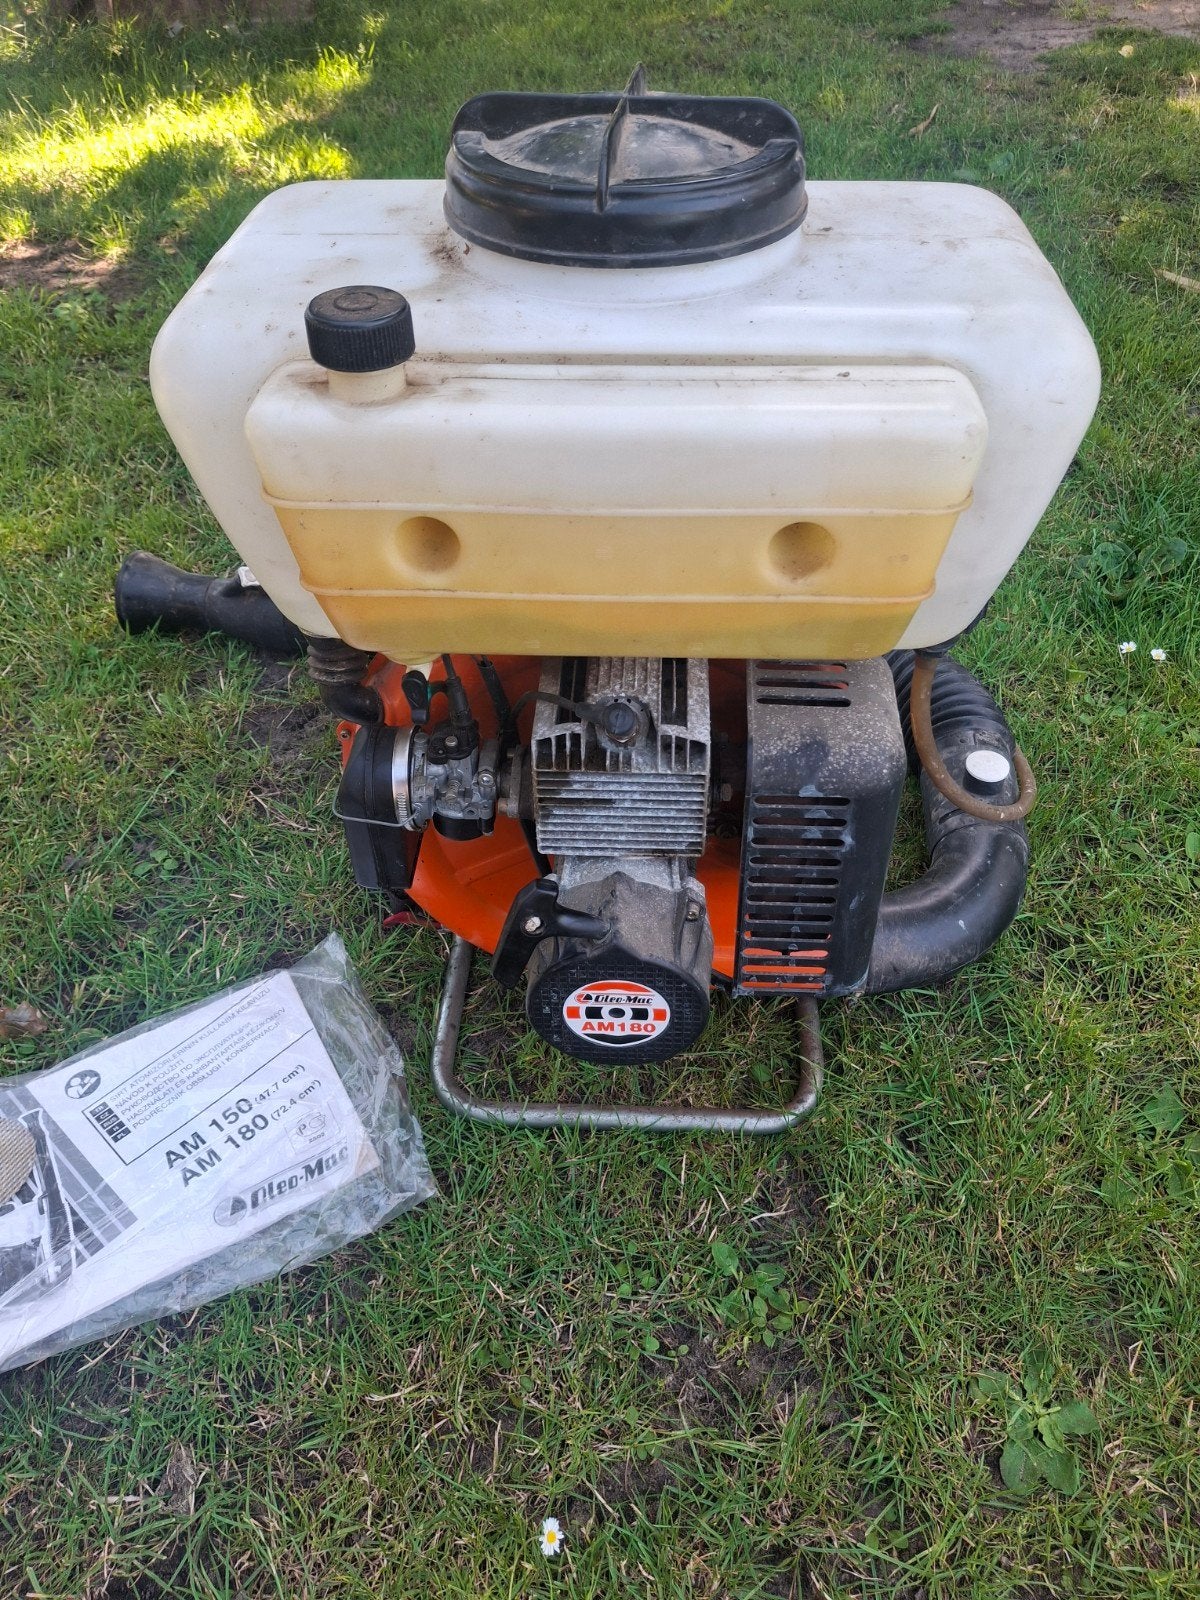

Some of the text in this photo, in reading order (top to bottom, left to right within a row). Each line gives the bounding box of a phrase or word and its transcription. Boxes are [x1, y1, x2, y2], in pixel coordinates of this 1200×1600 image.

[594, 994, 653, 1004] Oleo-Mac
[581, 1021, 656, 1033] AM180
[225, 1022, 280, 1062] KONSERWACJI
[180, 1063, 193, 1074] ПО
[109, 1086, 128, 1102] SIRT
[103, 1116, 118, 1127] RUS
[165, 1131, 207, 1169] AM
[208, 1098, 253, 1132] 150
[254, 1082, 280, 1104] (47.7
[181, 1148, 222, 1188] AM
[224, 1113, 269, 1149] 180
[270, 1098, 297, 1121] (72.4
[250, 1146, 349, 1209] Oleo-Mac
